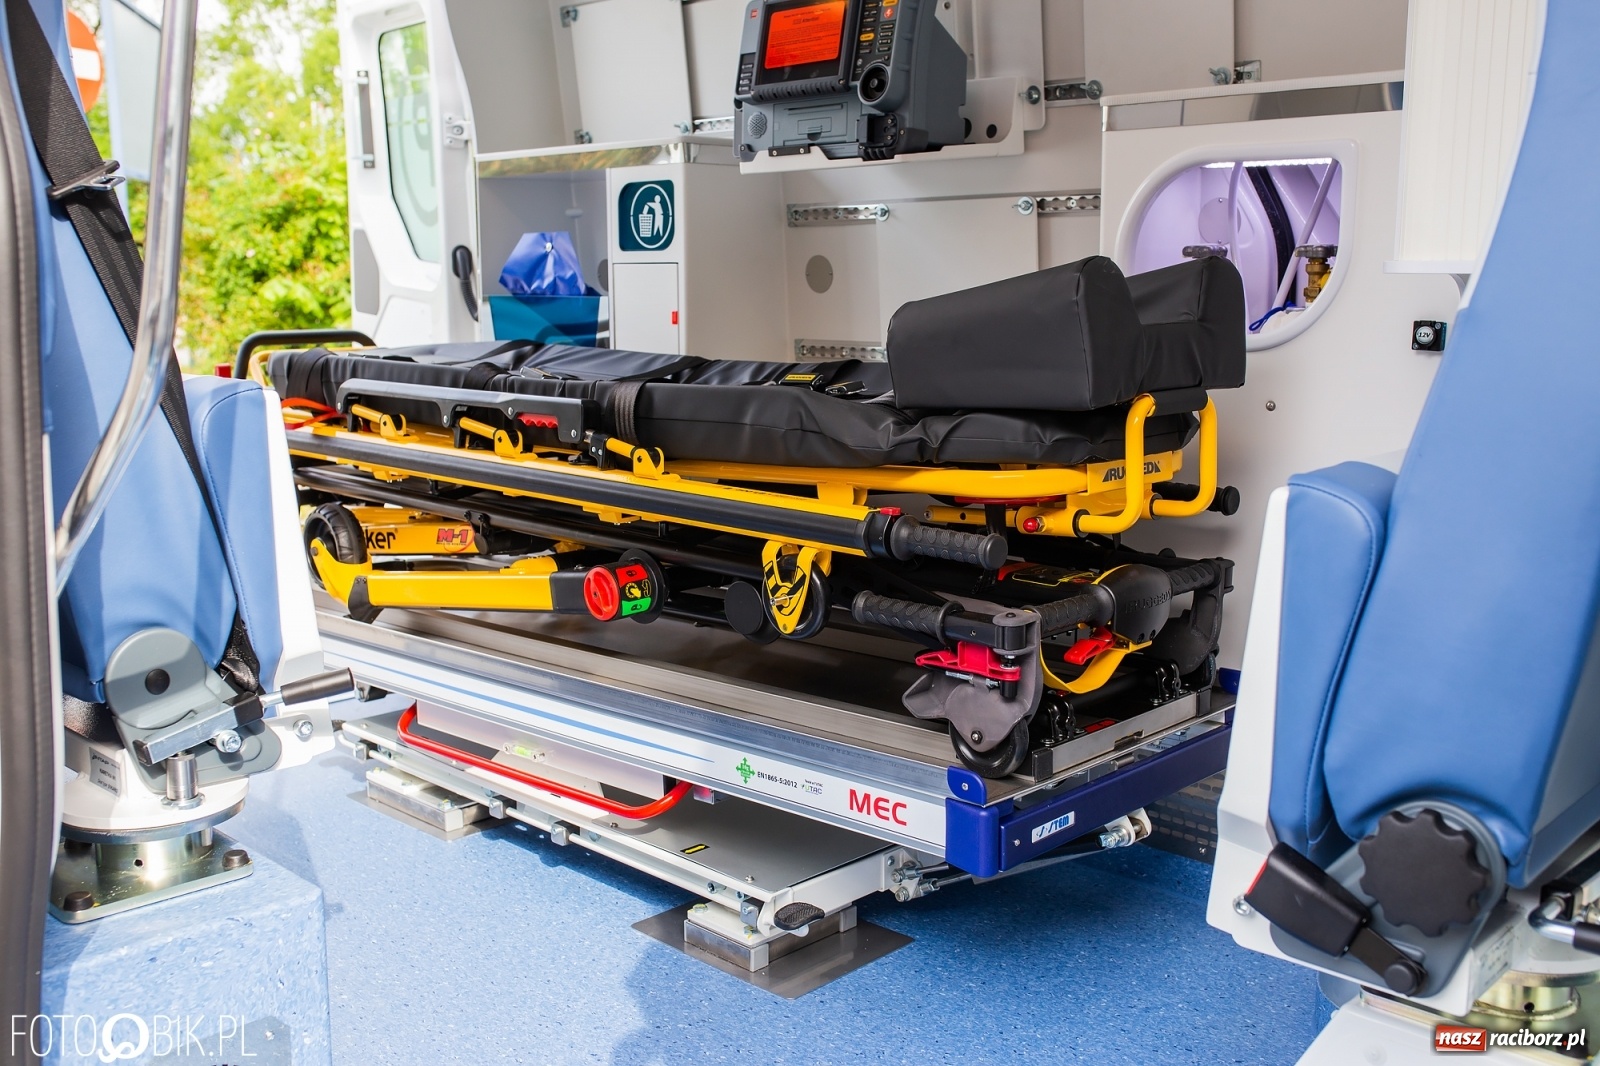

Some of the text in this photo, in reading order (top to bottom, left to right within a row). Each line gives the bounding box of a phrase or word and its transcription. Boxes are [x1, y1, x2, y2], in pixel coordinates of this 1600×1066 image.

[437, 528, 469, 543] M-1
[757, 771, 798, 789] EN1865-5:2012
[849, 788, 907, 826] MEC
